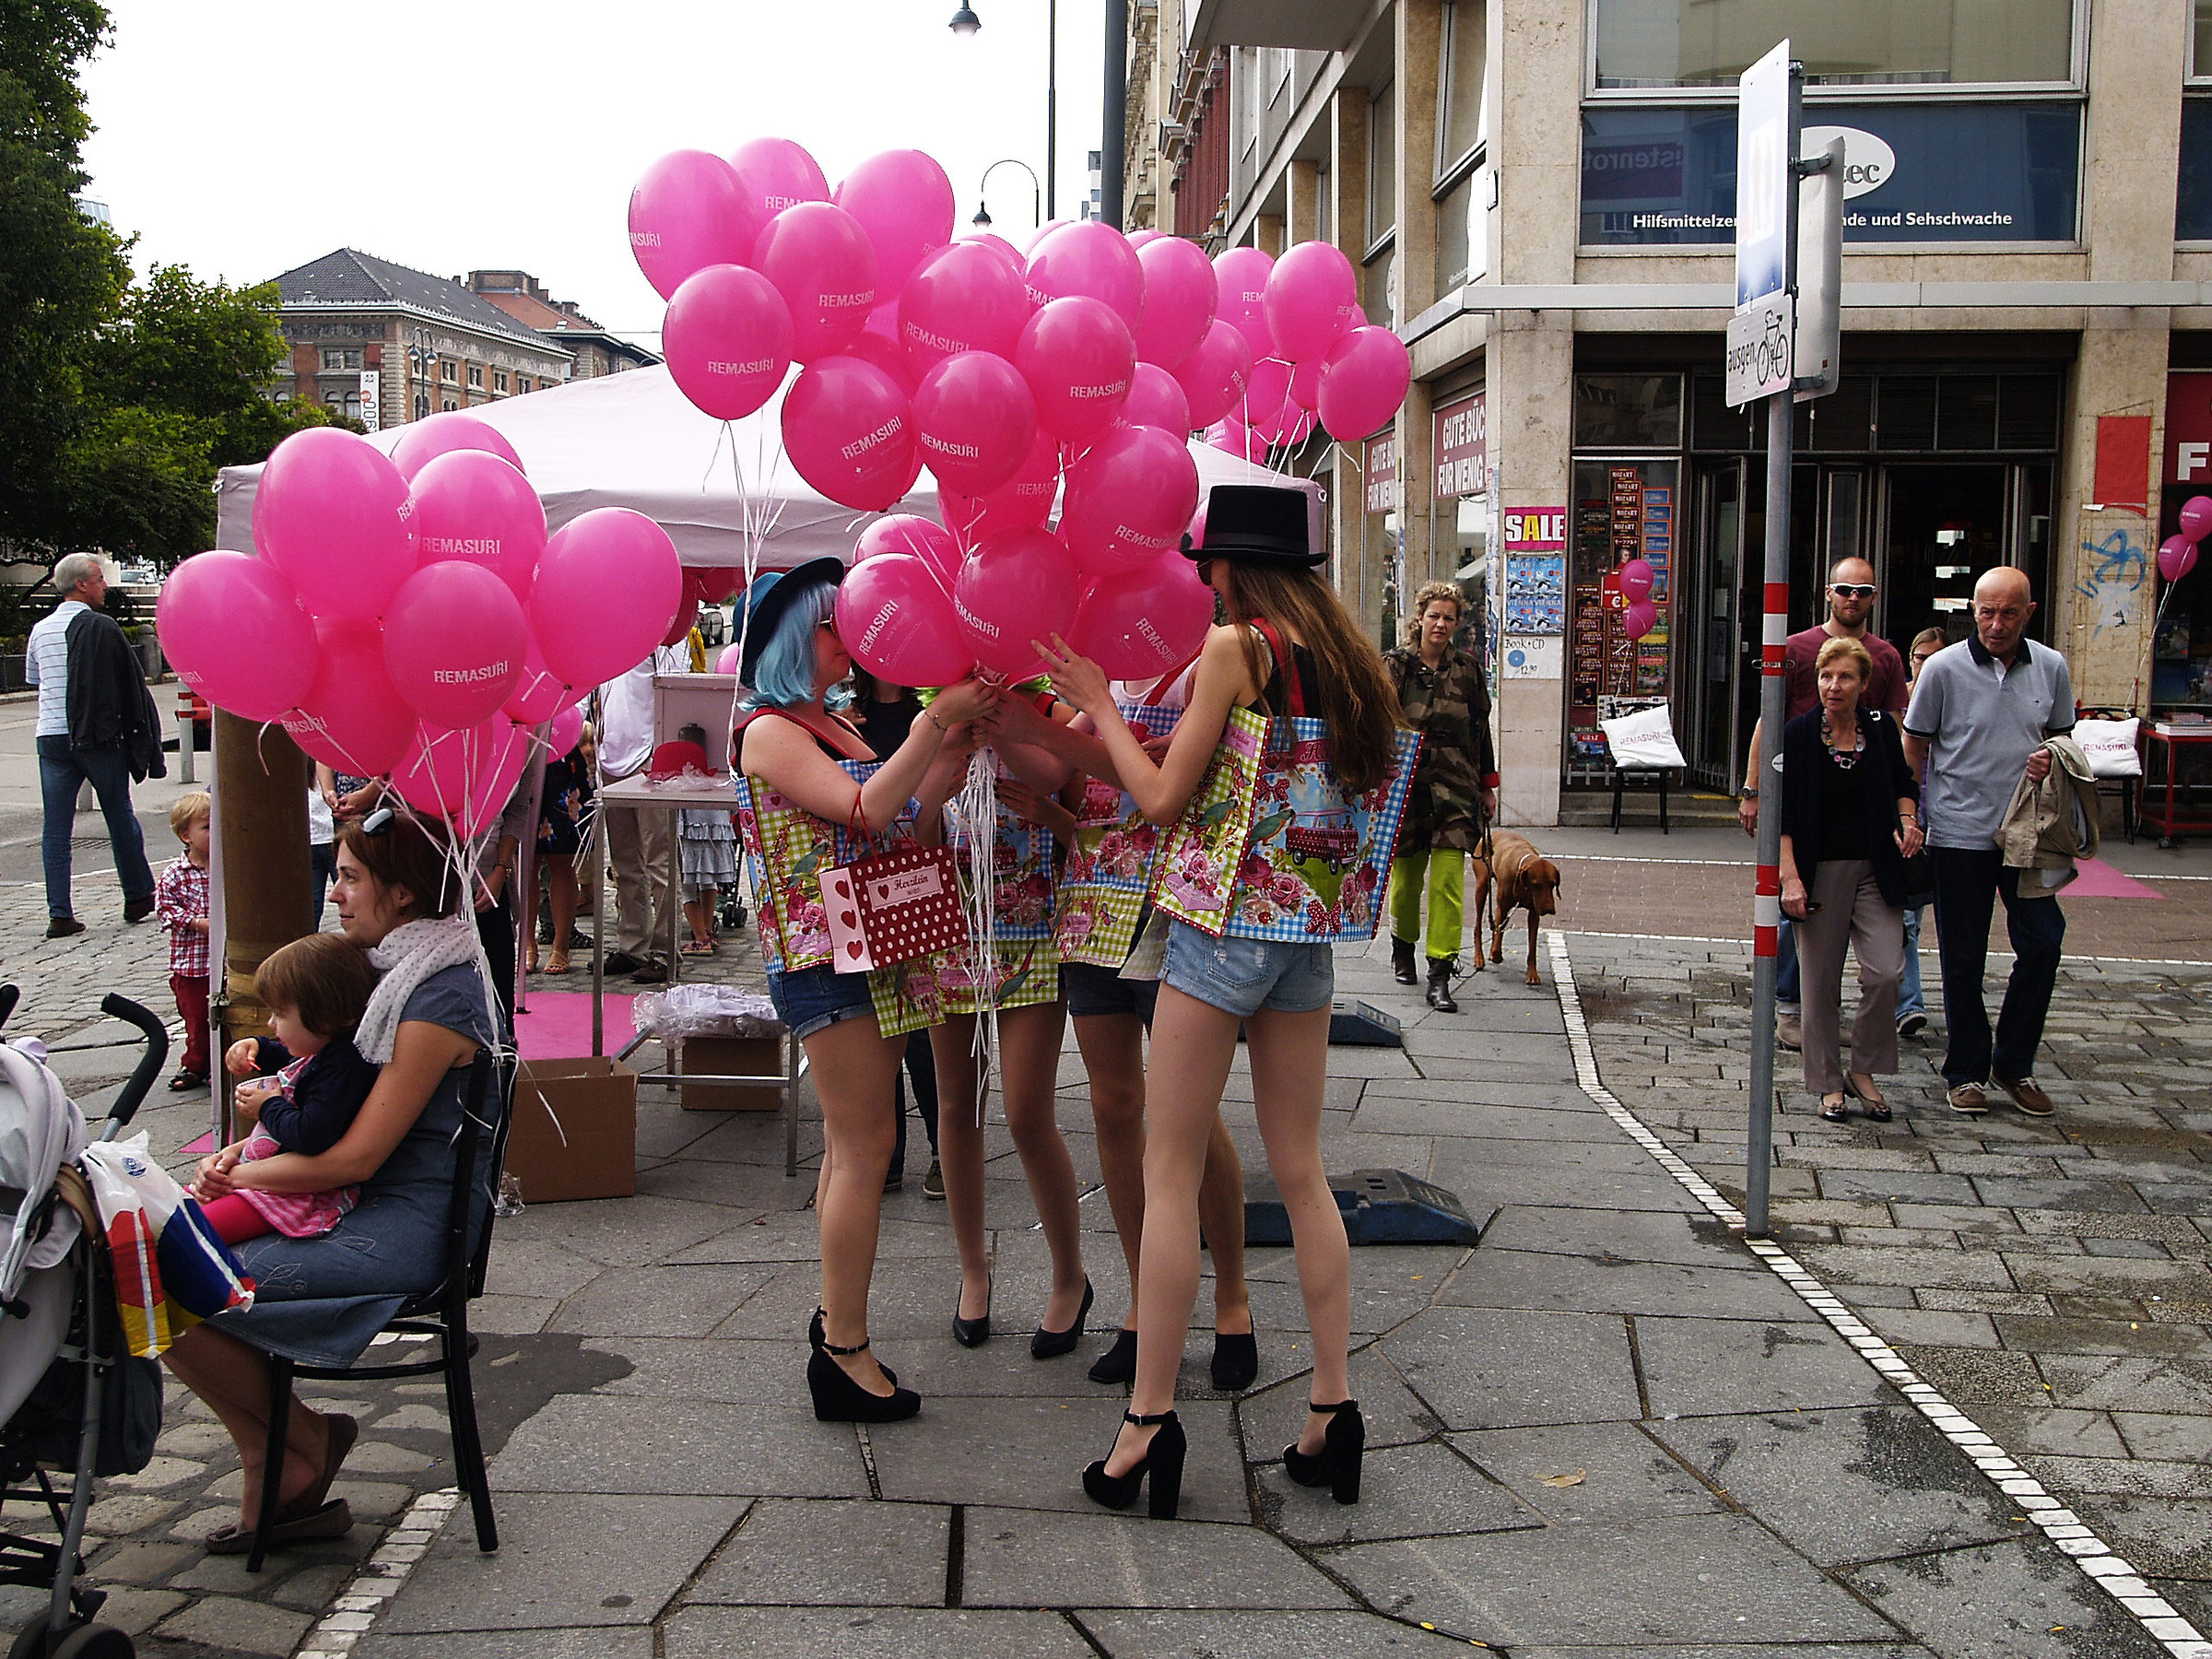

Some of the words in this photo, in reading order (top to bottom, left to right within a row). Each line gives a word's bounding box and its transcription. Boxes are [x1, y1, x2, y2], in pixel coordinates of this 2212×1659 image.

[1872, 212, 1900, 226] und
[1906, 211, 2012, 226] Sehschwache
[818, 289, 875, 308] REMASURI
[708, 358, 773, 376] REMASURI
[1070, 380, 1126, 399] REMASURI
[841, 415, 902, 460] REMASURI
[1443, 413, 1465, 452] GUTE
[1465, 399, 1486, 443] BÜC
[921, 431, 979, 458] REMASURI
[1438, 455, 1454, 497] FÜR
[1455, 453, 1484, 492] WENIG
[1505, 514, 1565, 542] SALE
[422, 537, 500, 554] REMASURI
[859, 599, 900, 655] REMASURI
[434, 660, 509, 684] REMASURI
